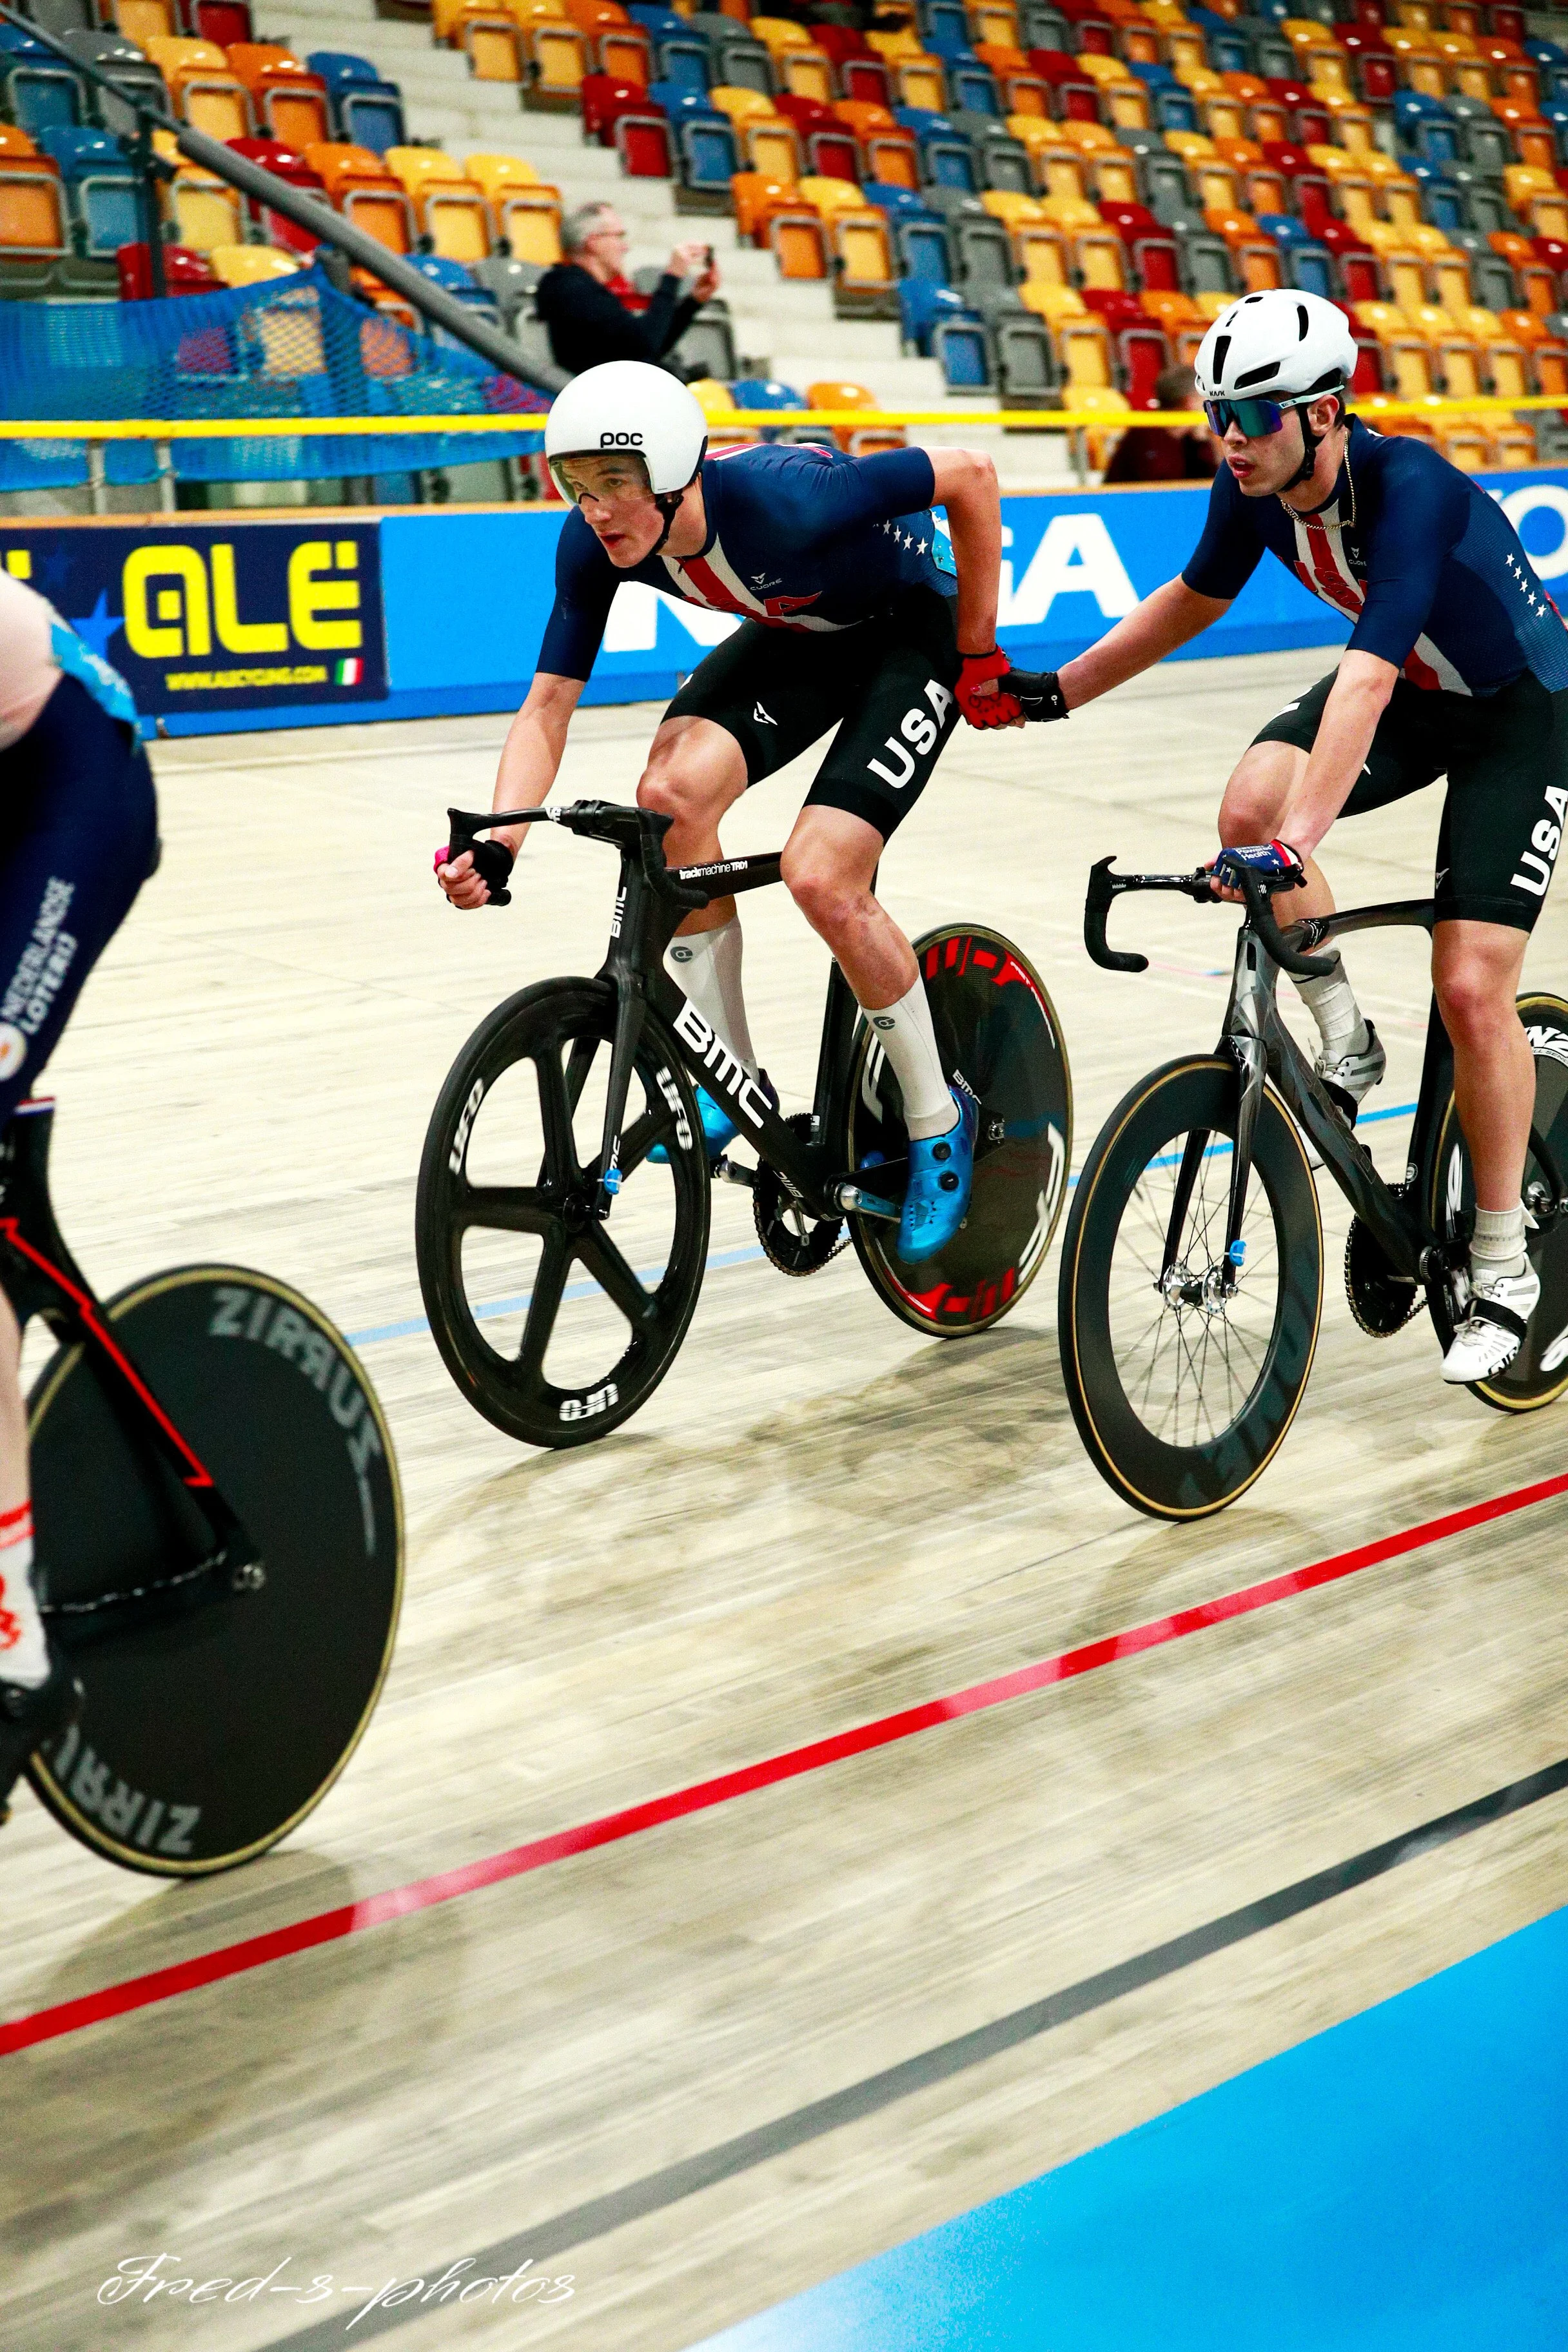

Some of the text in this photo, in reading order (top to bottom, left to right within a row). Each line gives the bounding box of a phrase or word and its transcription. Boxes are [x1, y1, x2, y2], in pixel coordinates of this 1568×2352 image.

[867, 679, 954, 789] USA
[679, 863, 730, 880] trackmachine
[1240, 850, 1271, 861] Health
[1511, 785, 1568, 896] USA
[611, 887, 627, 938] BMC
[673, 999, 773, 1128] BMC
